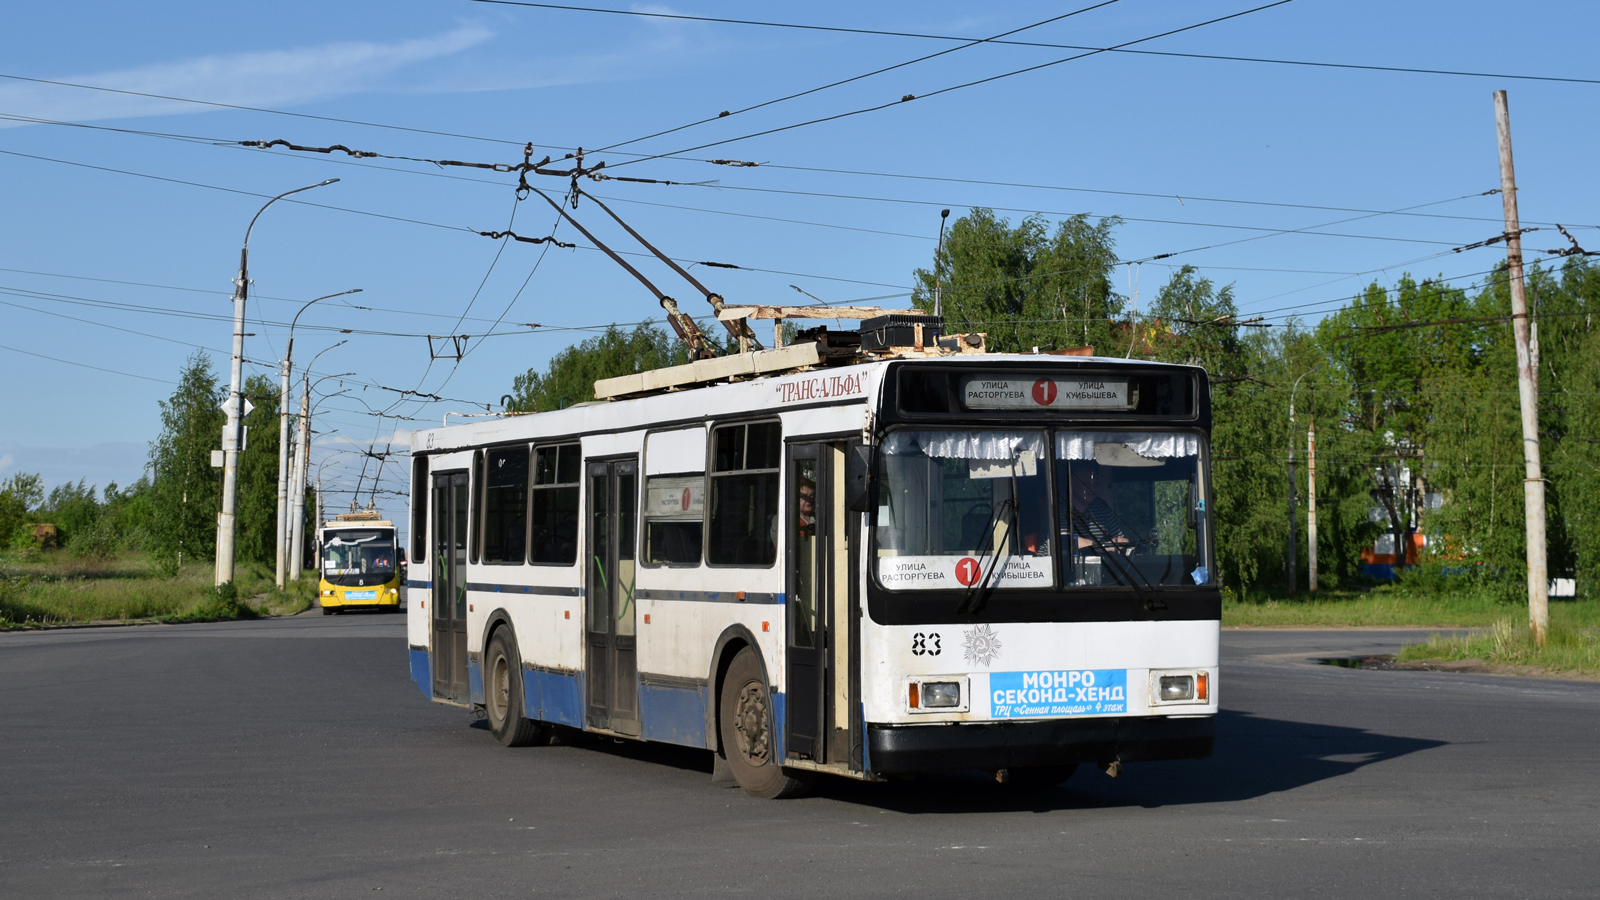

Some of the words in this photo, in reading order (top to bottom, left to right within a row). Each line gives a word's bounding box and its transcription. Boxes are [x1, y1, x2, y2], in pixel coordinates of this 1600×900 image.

[981, 382, 1009, 390] УЛИЦА
[1040, 381, 1049, 401] 1
[1078, 382, 1105, 390] УЛИЦА
[968, 391, 1025, 399] РАСТОРГУЕВА
[896, 563, 927, 571] УЛИЦА
[963, 561, 973, 582] 1
[882, 572, 945, 582] РАСТОРГУЕВА
[912, 632, 941, 656] 83
[1023, 670, 1095, 689] МОНРО
[993, 686, 1125, 705] СЕКОНД-ХЕНД
[994, 705, 1012, 717] ТРЦ
[1014, 704, 1049, 715] «Сенная
[1051, 704, 1093, 715] площадь»
[1095, 701, 1102, 712] 4
[1103, 703, 1124, 712] этаж
